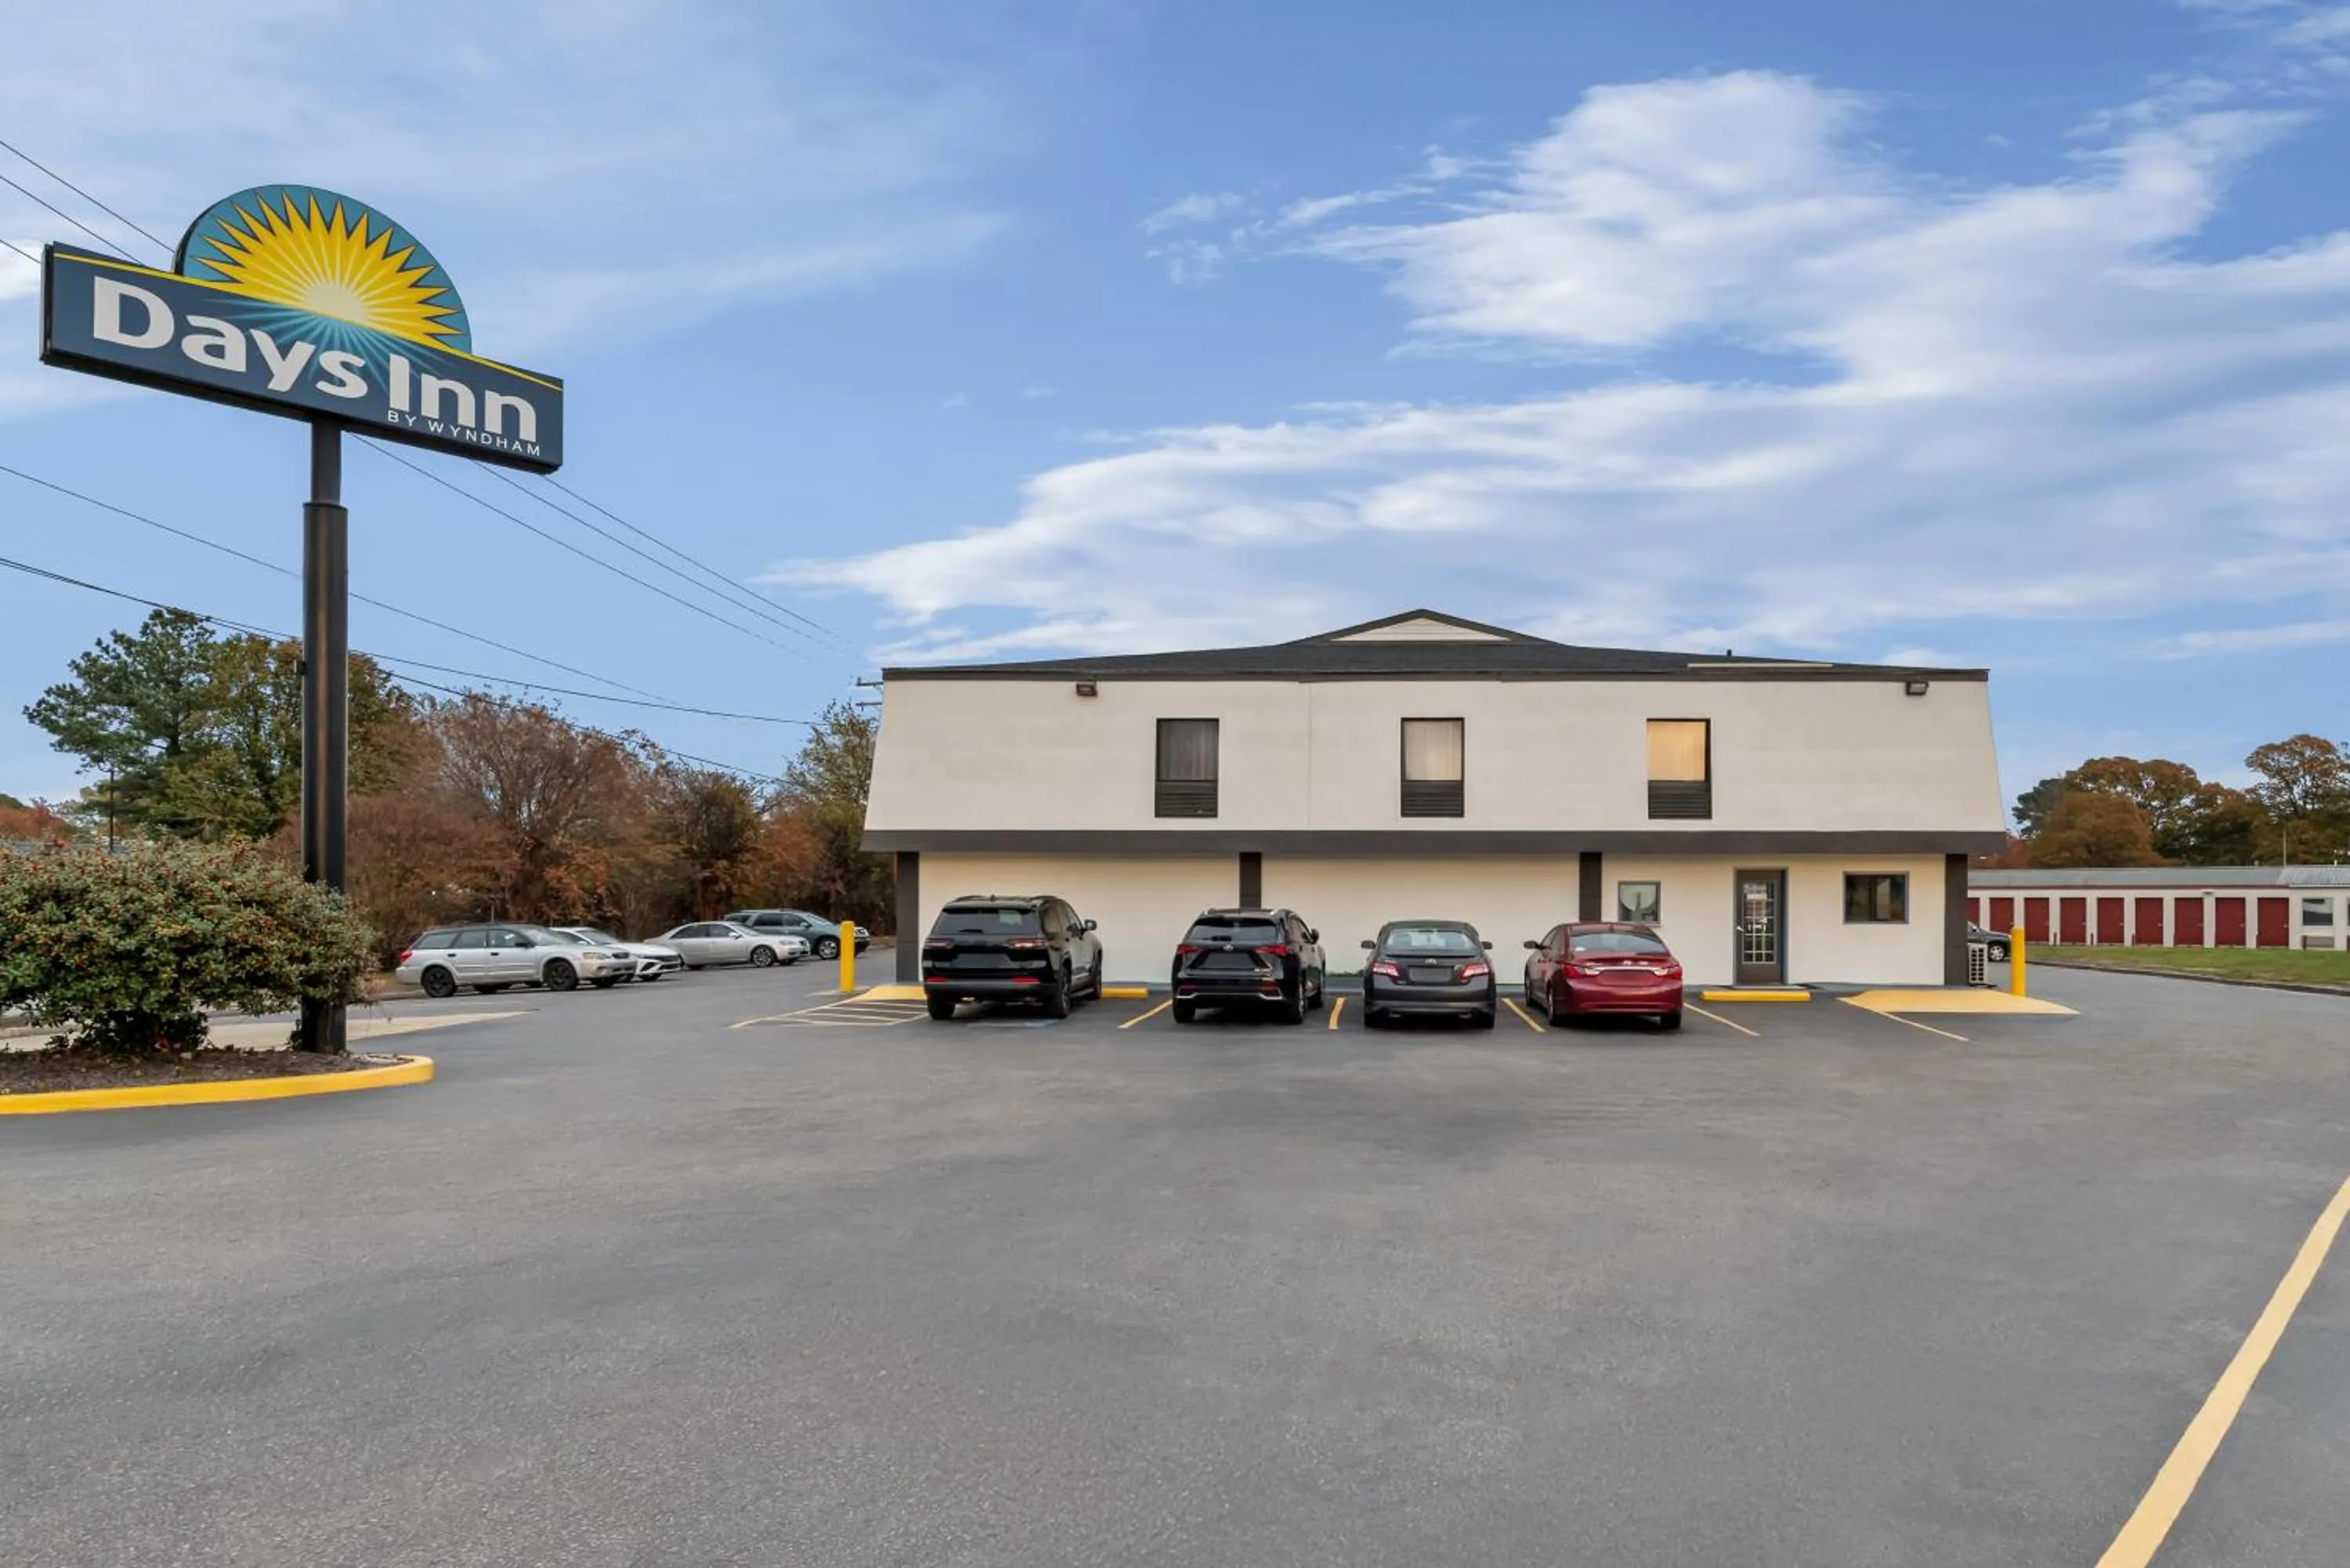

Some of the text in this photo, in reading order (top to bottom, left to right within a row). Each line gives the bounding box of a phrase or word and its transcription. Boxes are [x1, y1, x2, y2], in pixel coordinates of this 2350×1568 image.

[93, 276, 537, 443] Days Inn
[388, 410, 540, 457] BY WYNDHAM
